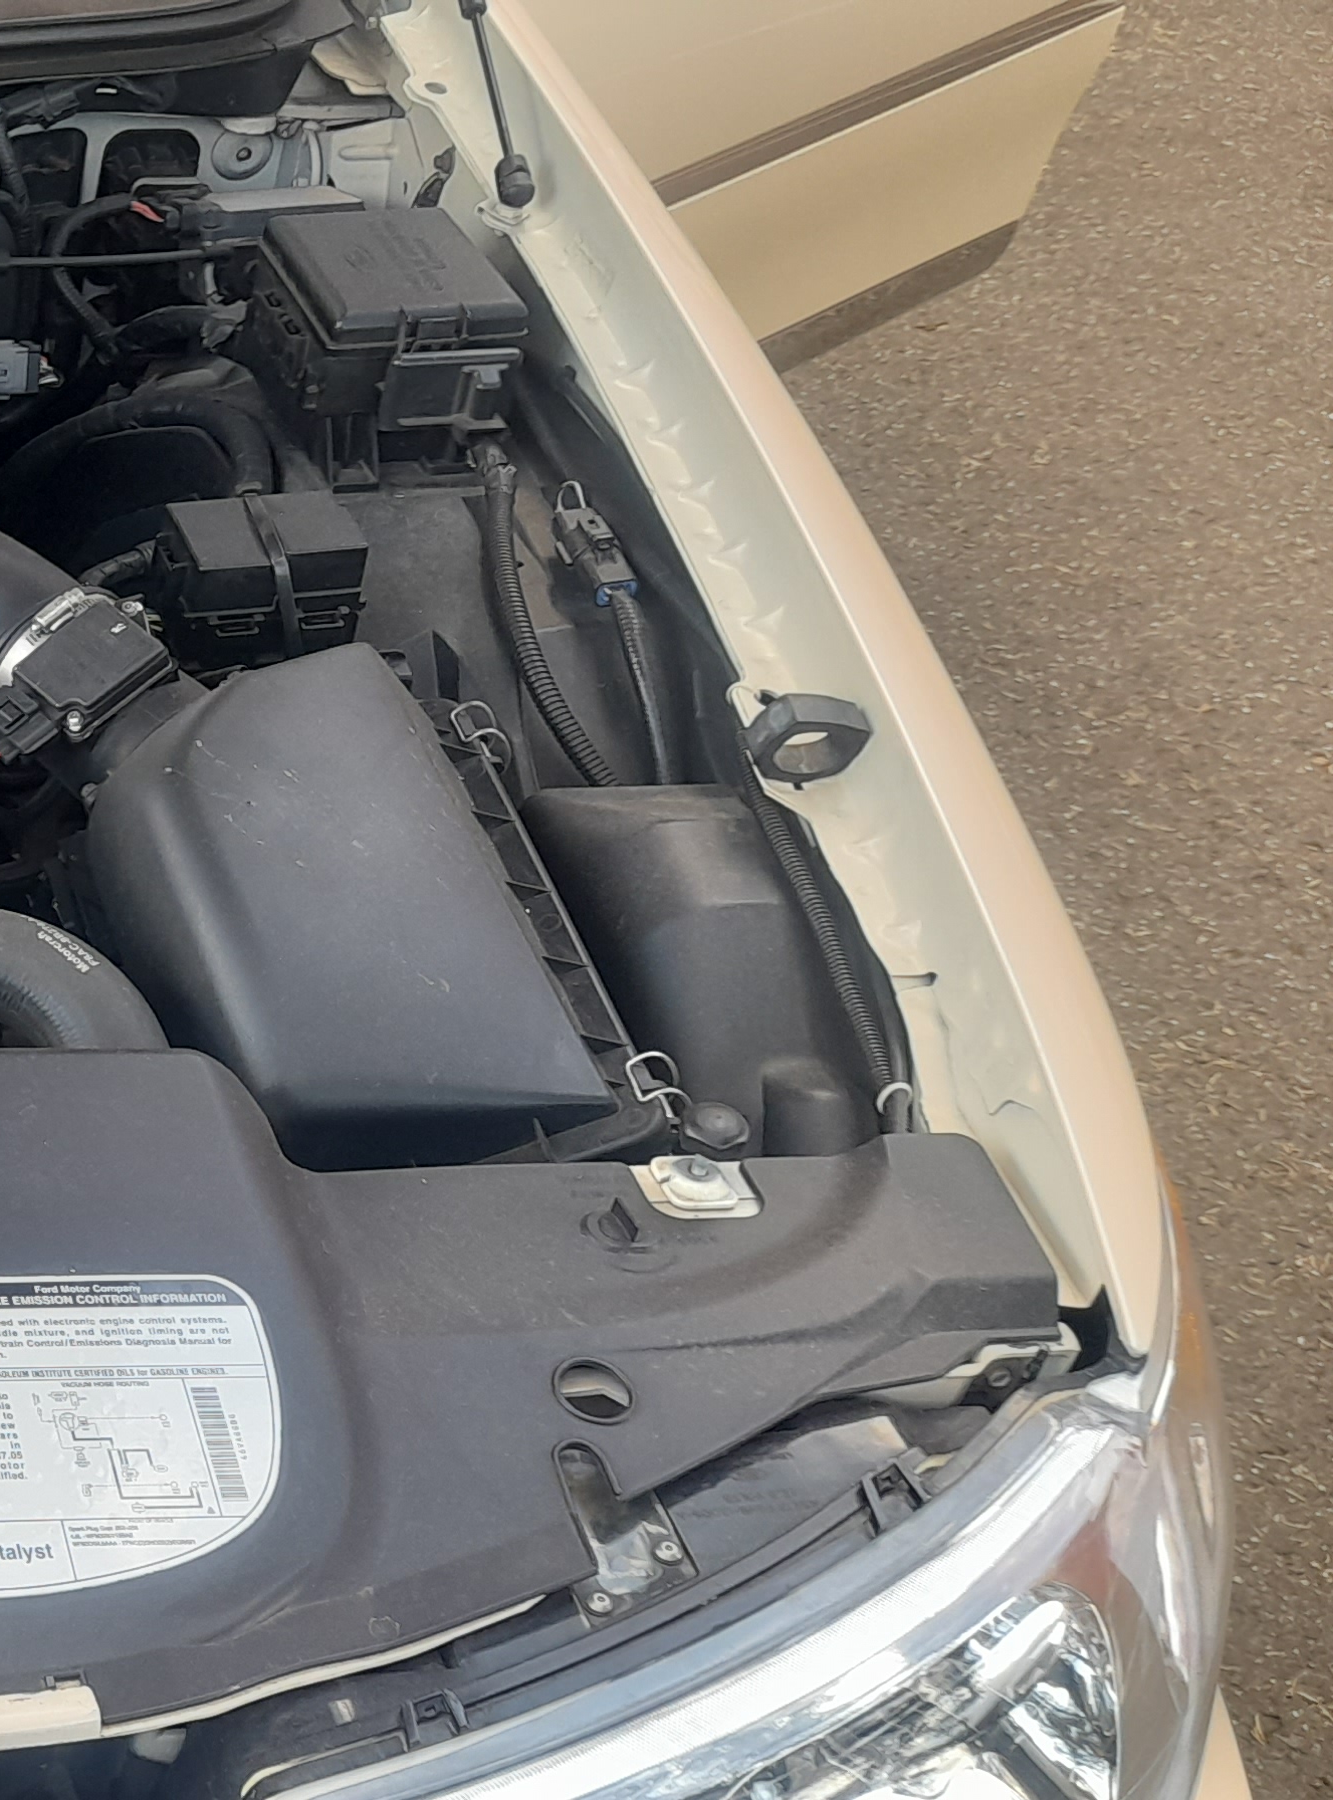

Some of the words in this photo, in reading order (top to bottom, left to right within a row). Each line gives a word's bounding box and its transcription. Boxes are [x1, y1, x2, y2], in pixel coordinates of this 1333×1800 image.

[36, 930, 90, 974] Motorcraft
[34, 1285, 59, 1295] Ford
[60, 1285, 90, 1294] Motor
[93, 1284, 141, 1295] Company
[12, 1295, 74, 1306] EMISSION
[76, 1294, 139, 1305] CONTROL
[140, 1293, 227, 1304] INFORMATION
[17, 1319, 39, 1327] with
[43, 1318, 96, 1326] electronic
[99, 1317, 135, 1327] engine
[139, 1317, 176, 1325] control
[75, 1328, 95, 1336] and
[100, 1327, 143, 1338] ignition
[148, 1327, 184, 1337] timing
[211, 1327, 230, 1335] not
[26, 1338, 123, 1348] Control/Emissions
[125, 1337, 177, 1348] Diagnosis
[179, 1337, 215, 1345] Manual
[217, 1336, 232, 1345] for
[3, 1412, 14, 1420] to
[10, 1441, 21, 1449] in
